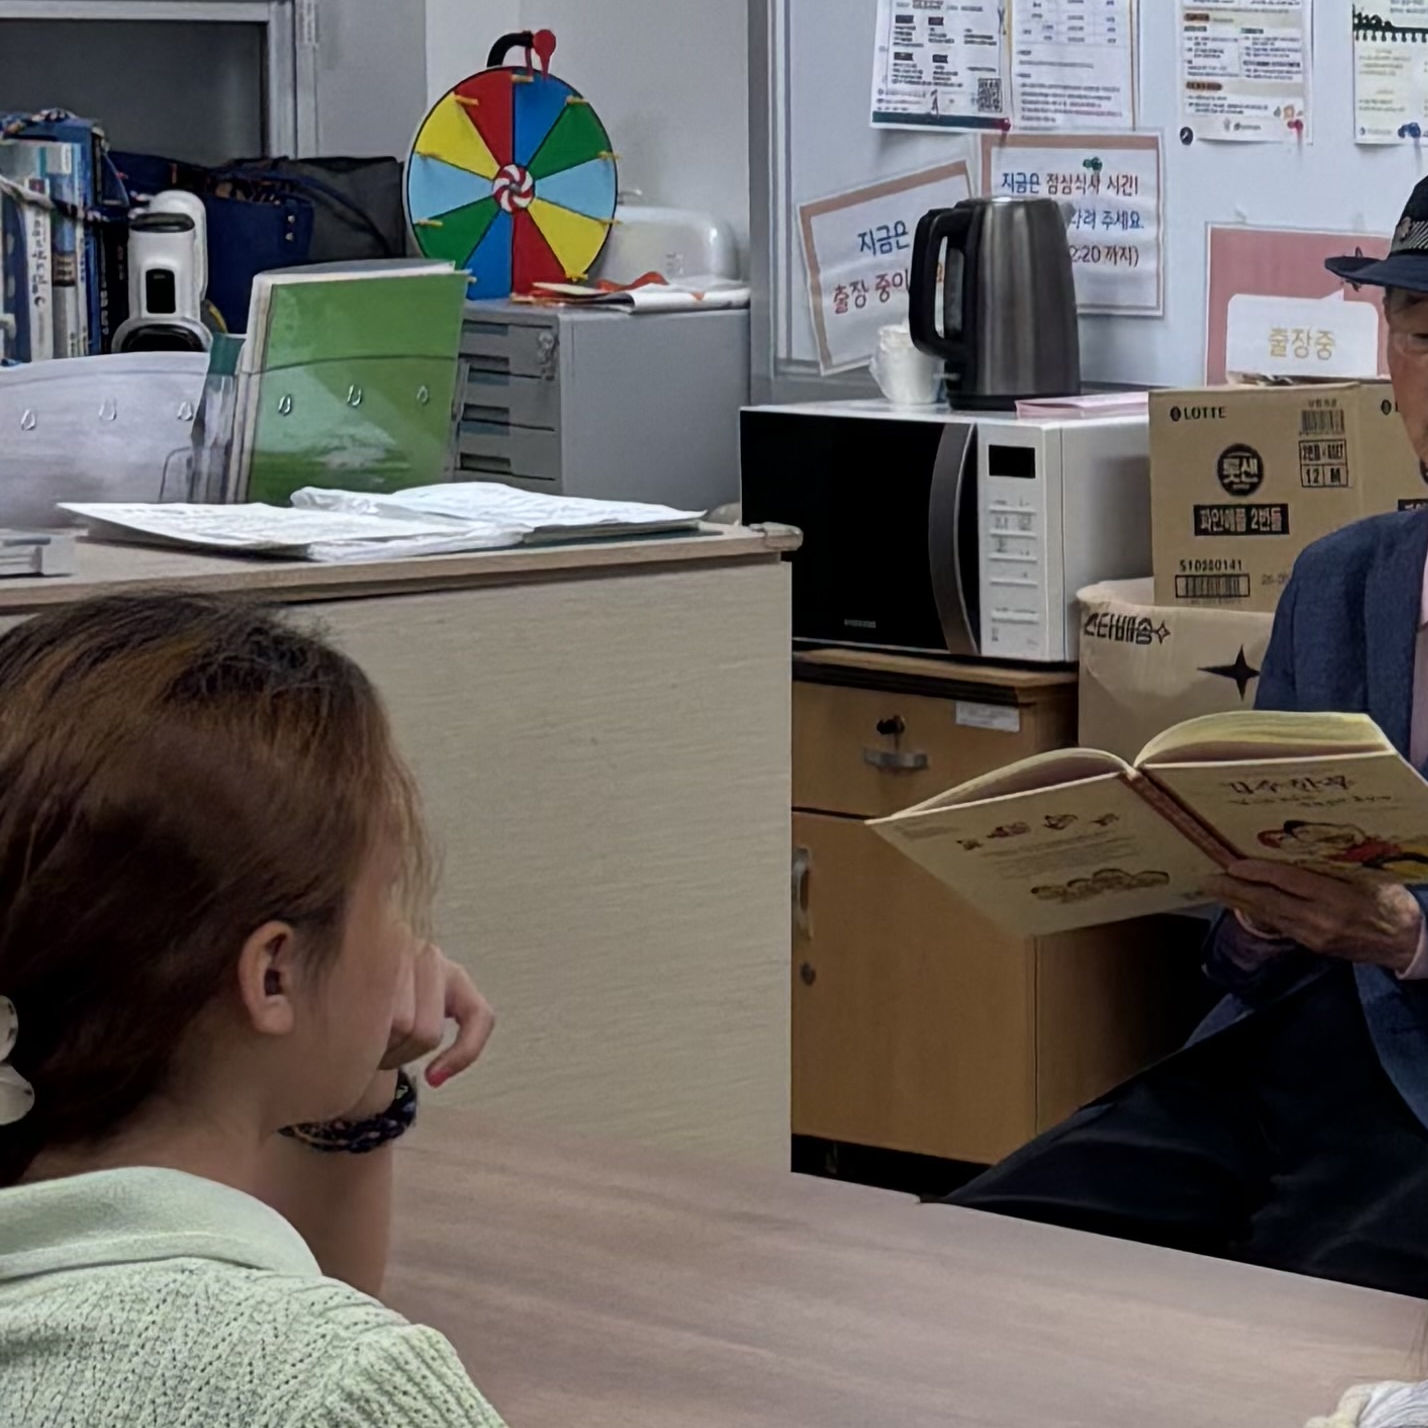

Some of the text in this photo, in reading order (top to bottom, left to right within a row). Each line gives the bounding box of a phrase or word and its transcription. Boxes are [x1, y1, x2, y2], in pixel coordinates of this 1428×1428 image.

[1001, 172, 1041, 194] 지금은
[1047, 173, 1101, 195] 점심식사
[857, 220, 910, 256] 지금은
[833, 279, 869, 315] 출장
[1267, 327, 1337, 361] 출장중
[1184, 405, 1227, 421] LOTTE
